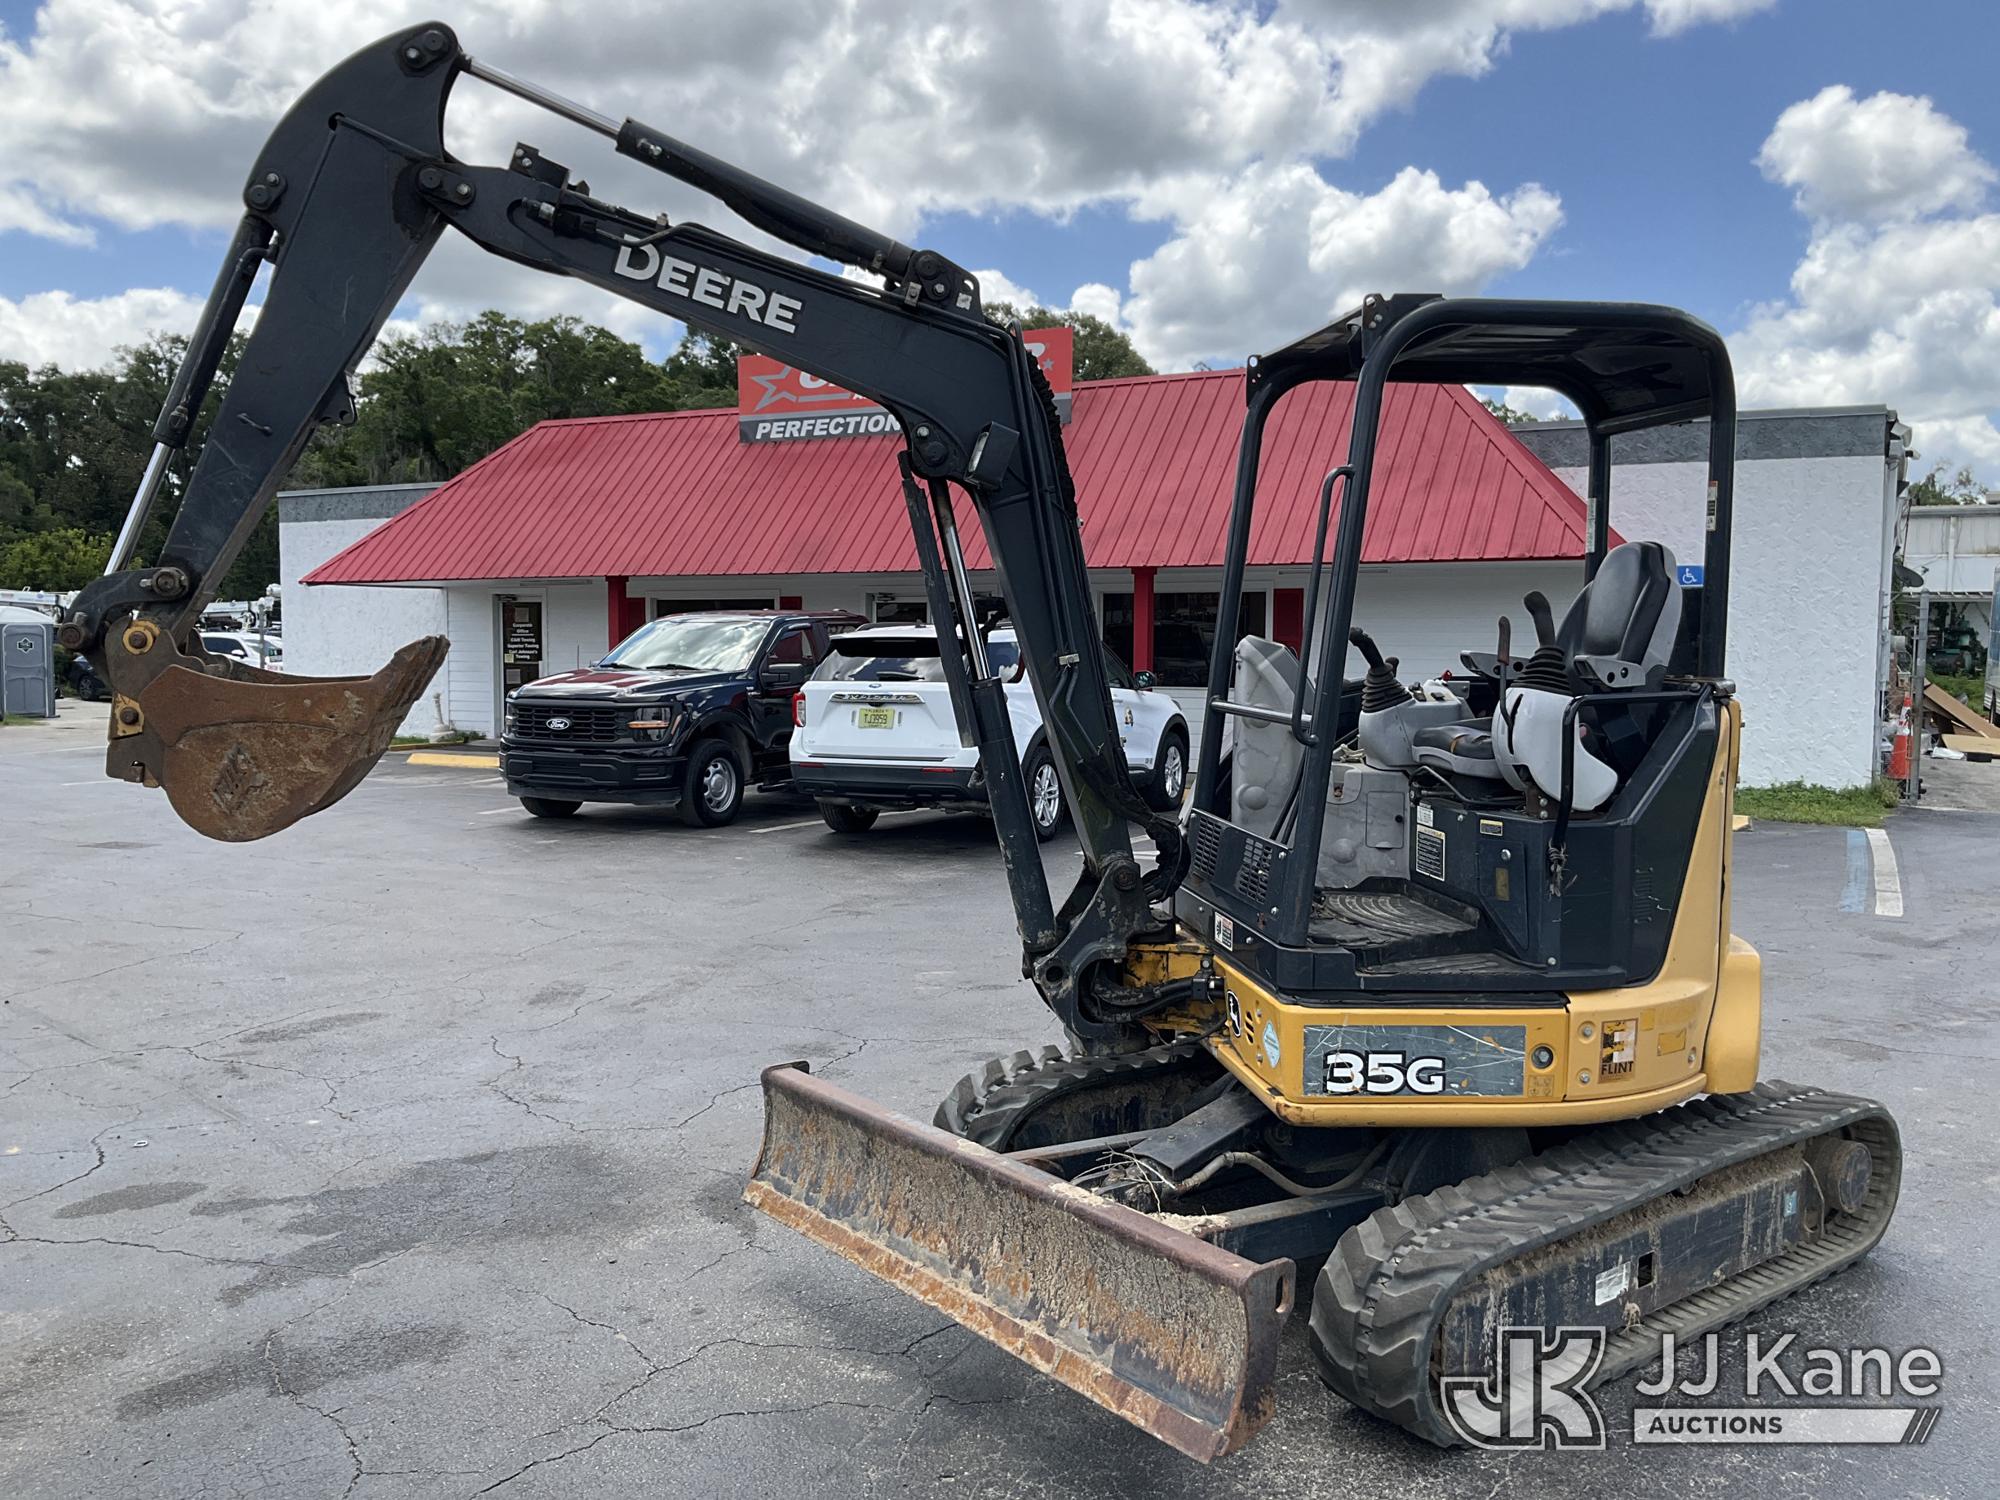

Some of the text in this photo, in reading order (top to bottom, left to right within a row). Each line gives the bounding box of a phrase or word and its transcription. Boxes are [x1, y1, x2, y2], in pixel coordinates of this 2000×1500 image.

[614, 234, 802, 334] DEERE
[755, 414, 901, 439] PERFECTION
[1325, 1050, 1445, 1094] 35G
[1601, 1061, 1634, 1075] FLINT
